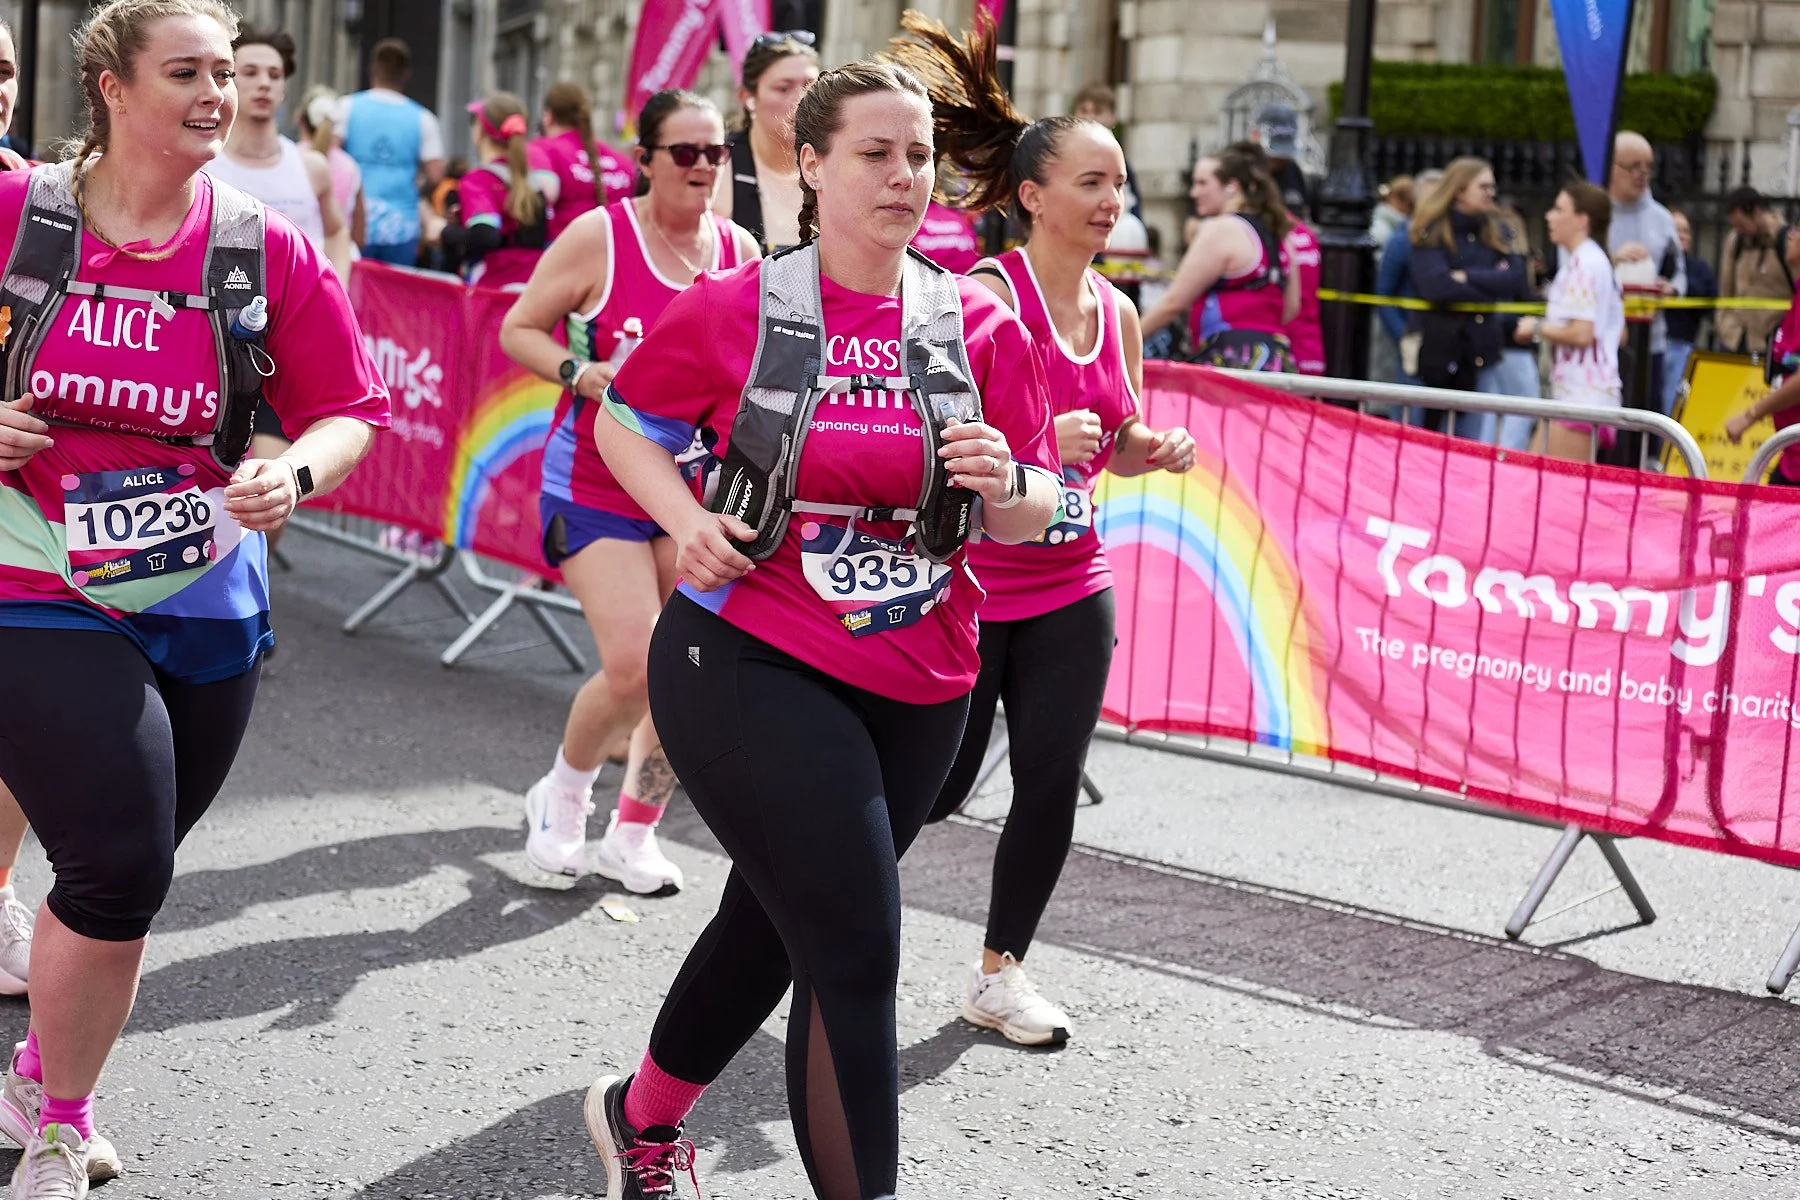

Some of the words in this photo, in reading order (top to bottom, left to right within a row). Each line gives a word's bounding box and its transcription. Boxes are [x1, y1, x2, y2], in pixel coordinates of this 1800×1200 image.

[67, 299, 161, 351] ALICE
[826, 335, 900, 371] CASS
[31, 370, 218, 426] ommy's
[809, 420, 869, 434] egnancy
[872, 423, 899, 434] and
[903, 423, 924, 437] ba
[123, 473, 164, 487] ALICE
[735, 479, 753, 520] AONIJI
[78, 492, 211, 545] 10236
[1065, 491, 1083, 519] 8
[860, 535, 906, 552] CASSI
[1365, 516, 1800, 666] Tommy's
[1355, 626, 1406, 660] The
[1412, 641, 1551, 692] pregnancy
[1558, 668, 1612, 698] and
[1620, 672, 1693, 715] baby
[1702, 684, 1800, 728] charity
